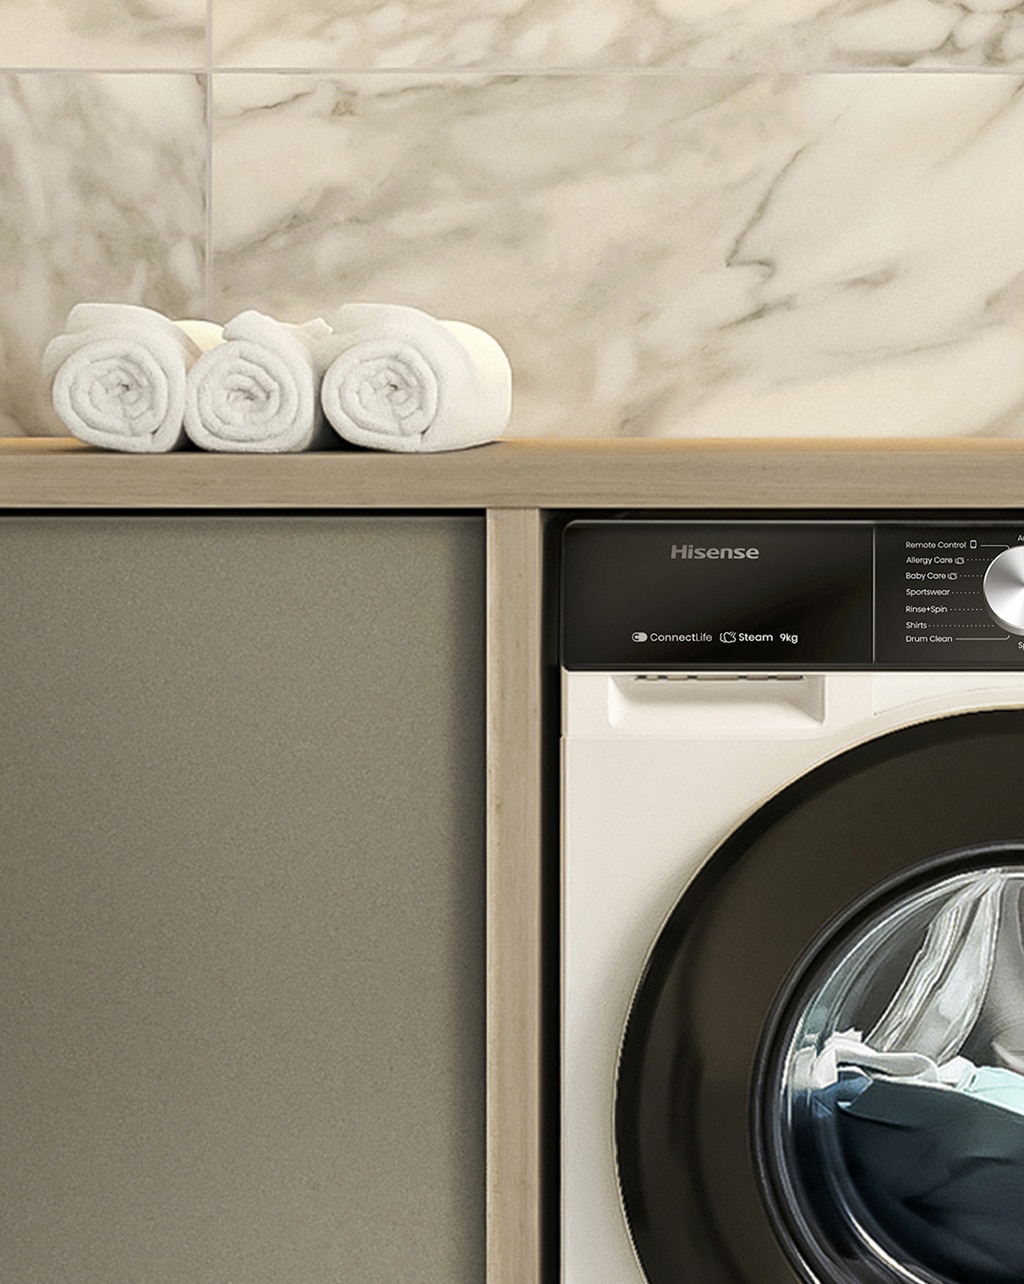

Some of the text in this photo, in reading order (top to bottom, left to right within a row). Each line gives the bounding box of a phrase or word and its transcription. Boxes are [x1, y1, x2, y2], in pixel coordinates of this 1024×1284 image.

[905, 541, 967, 549] Remote Control
[670, 544, 760, 560] Hisense
[906, 556, 953, 565] Allergy Care
[905, 572, 946, 582] Baby Care
[905, 588, 950, 598] Sportswear
[905, 606, 947, 614] Rinse+Spin
[905, 621, 927, 629] Shirts
[650, 632, 713, 642] ConnectLife
[738, 632, 774, 642] Steam
[779, 632, 799, 644] 9kg
[905, 635, 953, 643] Drum Clean
